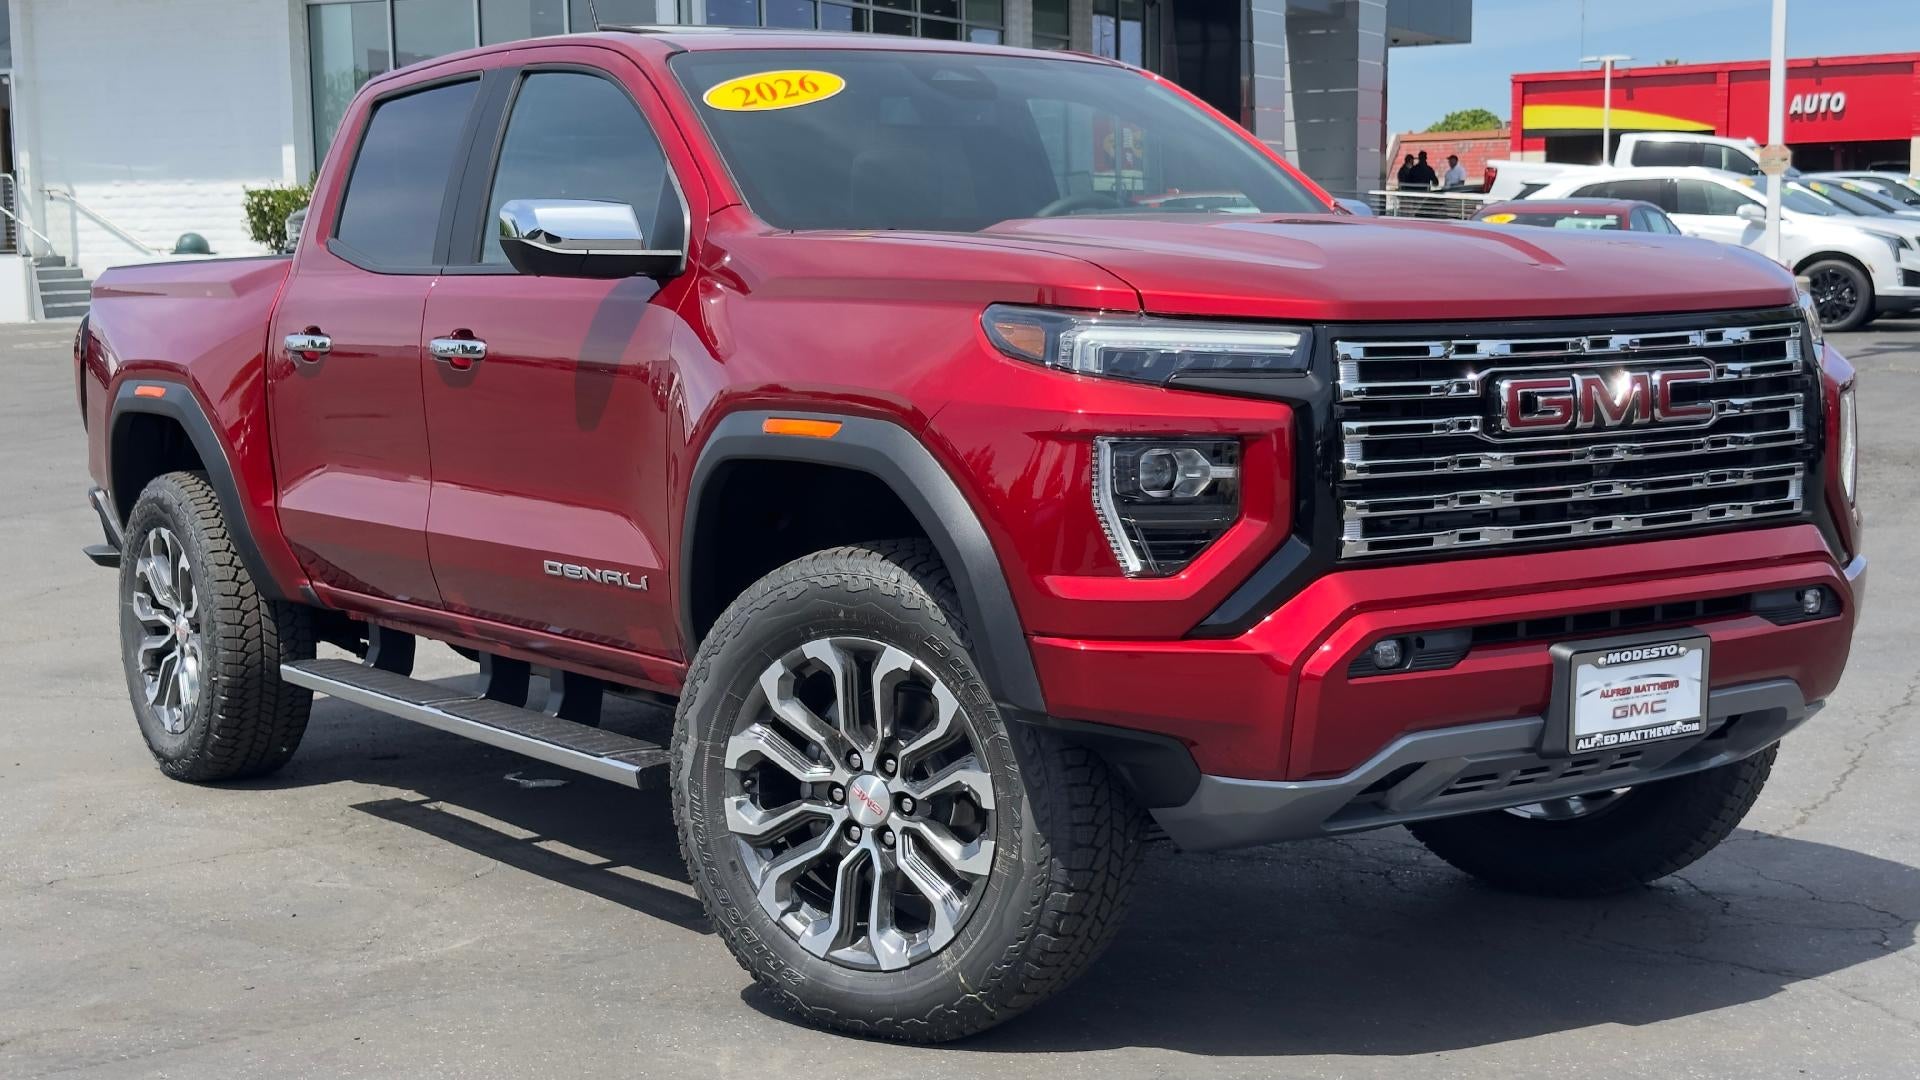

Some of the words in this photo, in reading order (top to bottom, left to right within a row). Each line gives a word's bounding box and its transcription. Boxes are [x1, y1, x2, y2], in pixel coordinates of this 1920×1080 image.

[731, 74, 820, 107] 2026
[1789, 91, 1846, 115] AUTO
[1500, 367, 1714, 433] GMC
[543, 559, 649, 592] DENALI
[1606, 644, 1678, 665] MODESTO
[1599, 686, 1632, 699] ALFRED
[1633, 679, 1680, 694] MATTHEWS
[1612, 699, 1667, 720] GMC
[852, 782, 884, 816] GMC
